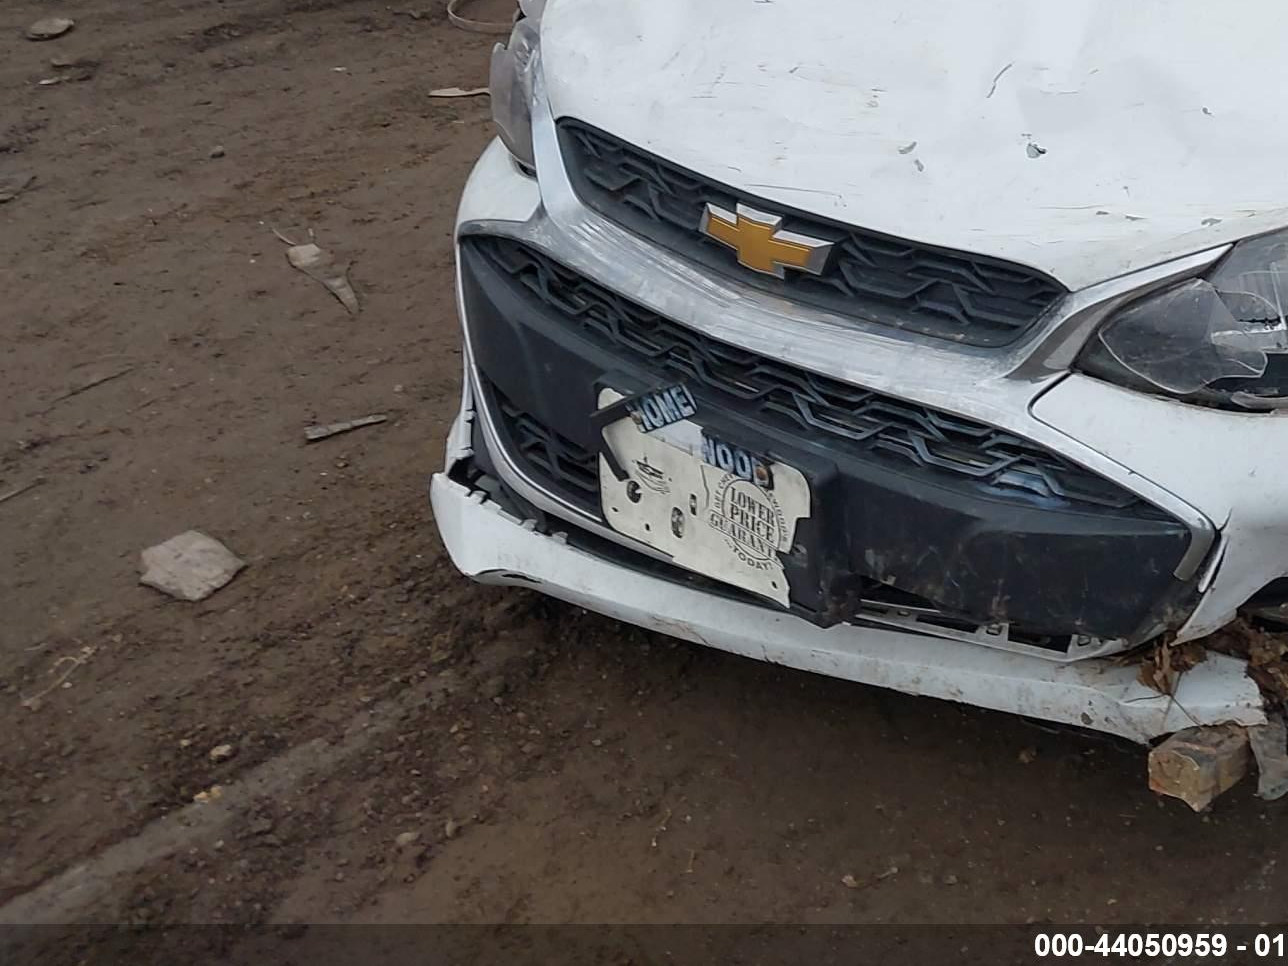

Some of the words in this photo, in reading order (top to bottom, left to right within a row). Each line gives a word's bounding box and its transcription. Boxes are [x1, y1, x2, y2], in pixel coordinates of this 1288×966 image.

[730, 486, 776, 528] LOWER
[730, 503, 775, 544] PRICE
[709, 512, 779, 561] GUARANT
